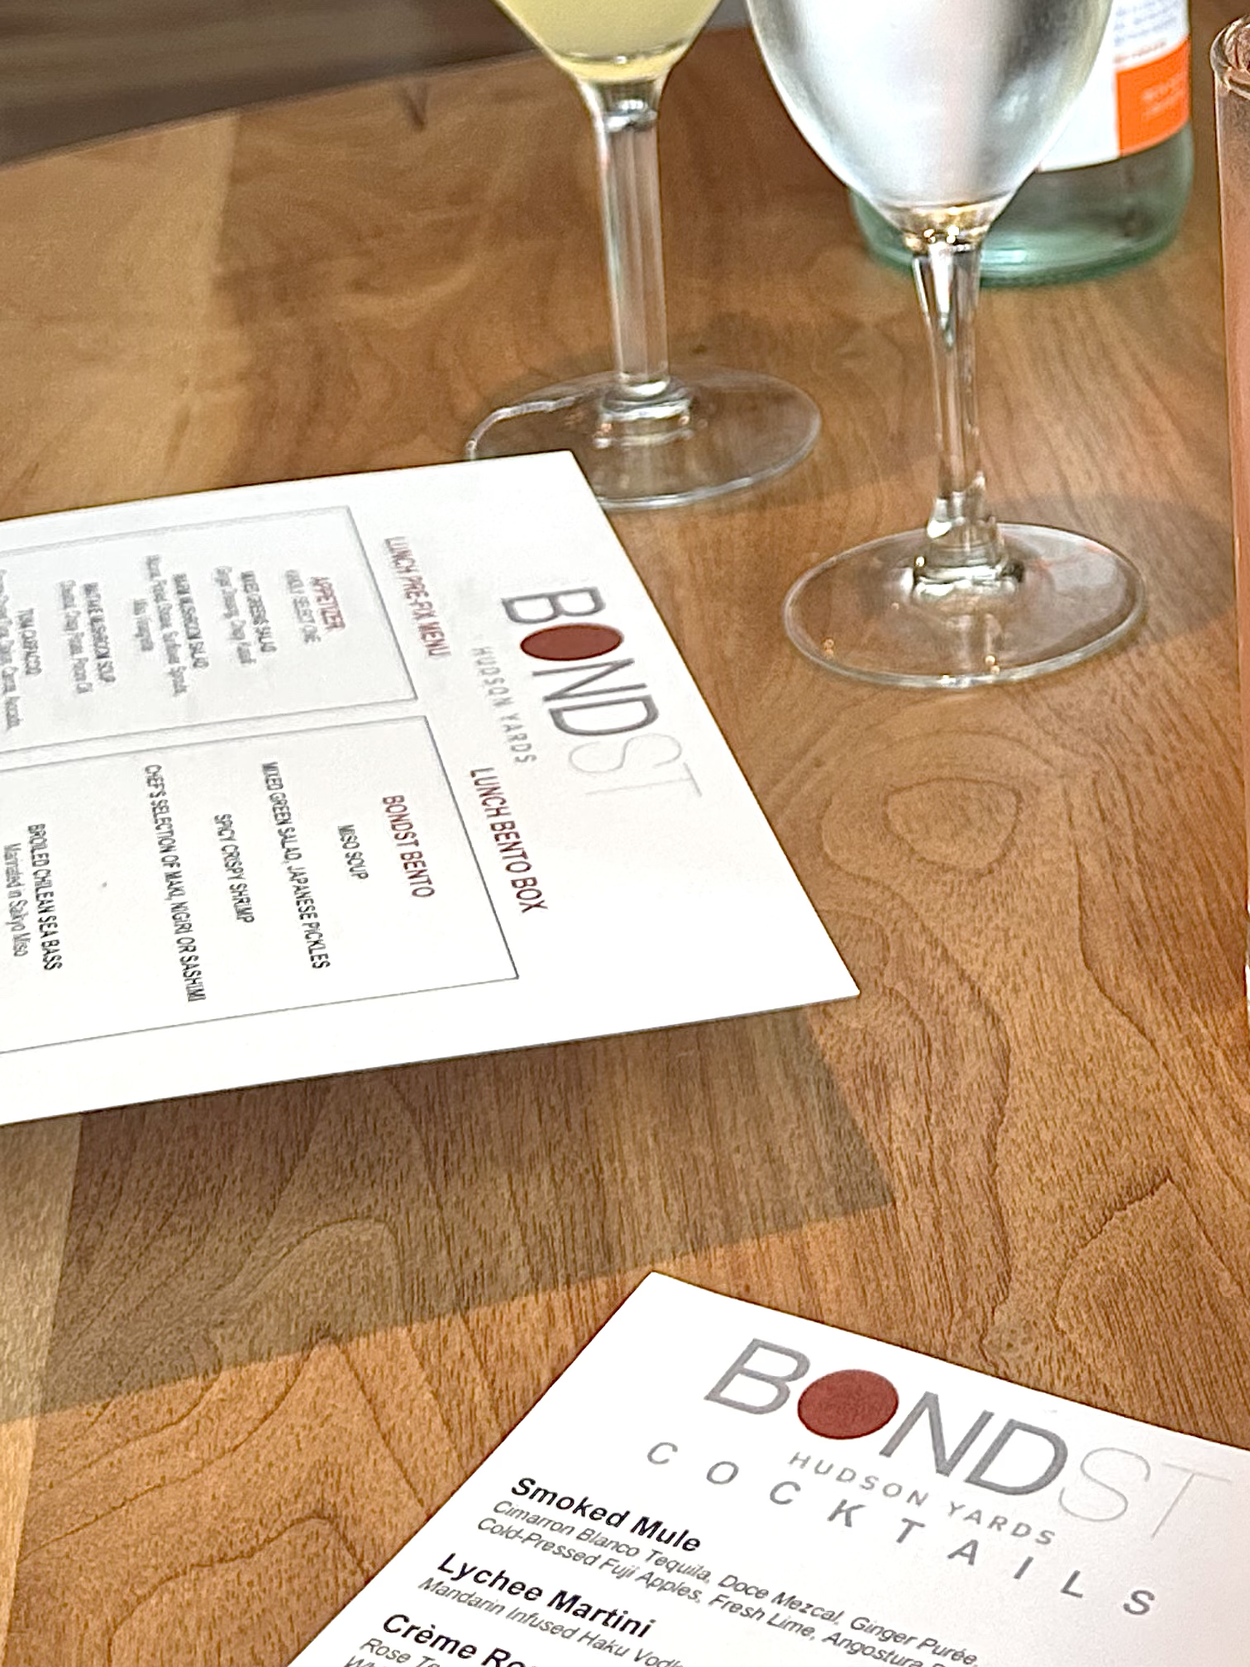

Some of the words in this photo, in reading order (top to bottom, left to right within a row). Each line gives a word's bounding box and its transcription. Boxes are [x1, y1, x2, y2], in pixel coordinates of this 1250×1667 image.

[385, 536, 416, 574] LUNCH
[418, 621, 451, 657] MENU
[471, 646, 514, 707] HUDSON
[499, 713, 537, 763] YARDS
[268, 792, 292, 827] GREEN
[470, 767, 511, 818] LUNCH
[28, 823, 50, 867] BROILED
[150, 799, 177, 854] SELECTION
[214, 814, 237, 842] SPICY
[337, 824, 360, 850] MISO
[382, 795, 419, 847] BONDST
[161, 854, 181, 869] OF
[220, 844, 246, 880] CRISPY
[344, 851, 369, 880] SOUP
[490, 820, 532, 874] BENTO
[287, 865, 318, 921] JAPANESE
[400, 850, 435, 897] BENTO
[511, 877, 548, 913] BOX
[37, 915, 59, 939] SEA
[229, 883, 255, 924] SHRIMP
[41, 939, 63, 971] BASS
[176, 937, 197, 953] OR
[302, 921, 331, 969] PICKLES
[180, 954, 207, 1003] SASHIMI
[511, 1477, 630, 1528] Smoked
[630, 1516, 701, 1552] Mule
[788, 1450, 930, 1507] HUDSON
[946, 1500, 1060, 1547] YARDS
[646, 1442, 1157, 1617] COCKTAILS
[437, 1552, 543, 1601] Lychee
[547, 1589, 657, 1638] Martini
[478, 1517, 602, 1566] Cold-Pressed
[599, 1558, 640, 1580] Fuji
[635, 1571, 702, 1604] Apples,
[708, 1594, 766, 1621] Fresh
[766, 1612, 816, 1641] Lime,
[821, 1632, 924, 1667] Angostura
[493, 1500, 575, 1536] Cimarron
[576, 1528, 640, 1557] Blanco
[646, 1549, 712, 1584] Tequila,
[717, 1574, 770, 1600] Doce
[771, 1591, 845, 1626] Mezcal,
[850, 1616, 918, 1645] Ginger
[383, 1614, 478, 1659] Crème
[418, 1577, 506, 1615] Mandarin
[505, 1607, 581, 1639] Infused
[577, 1631, 631, 1657] Haku
[359, 1637, 411, 1664] Rose
